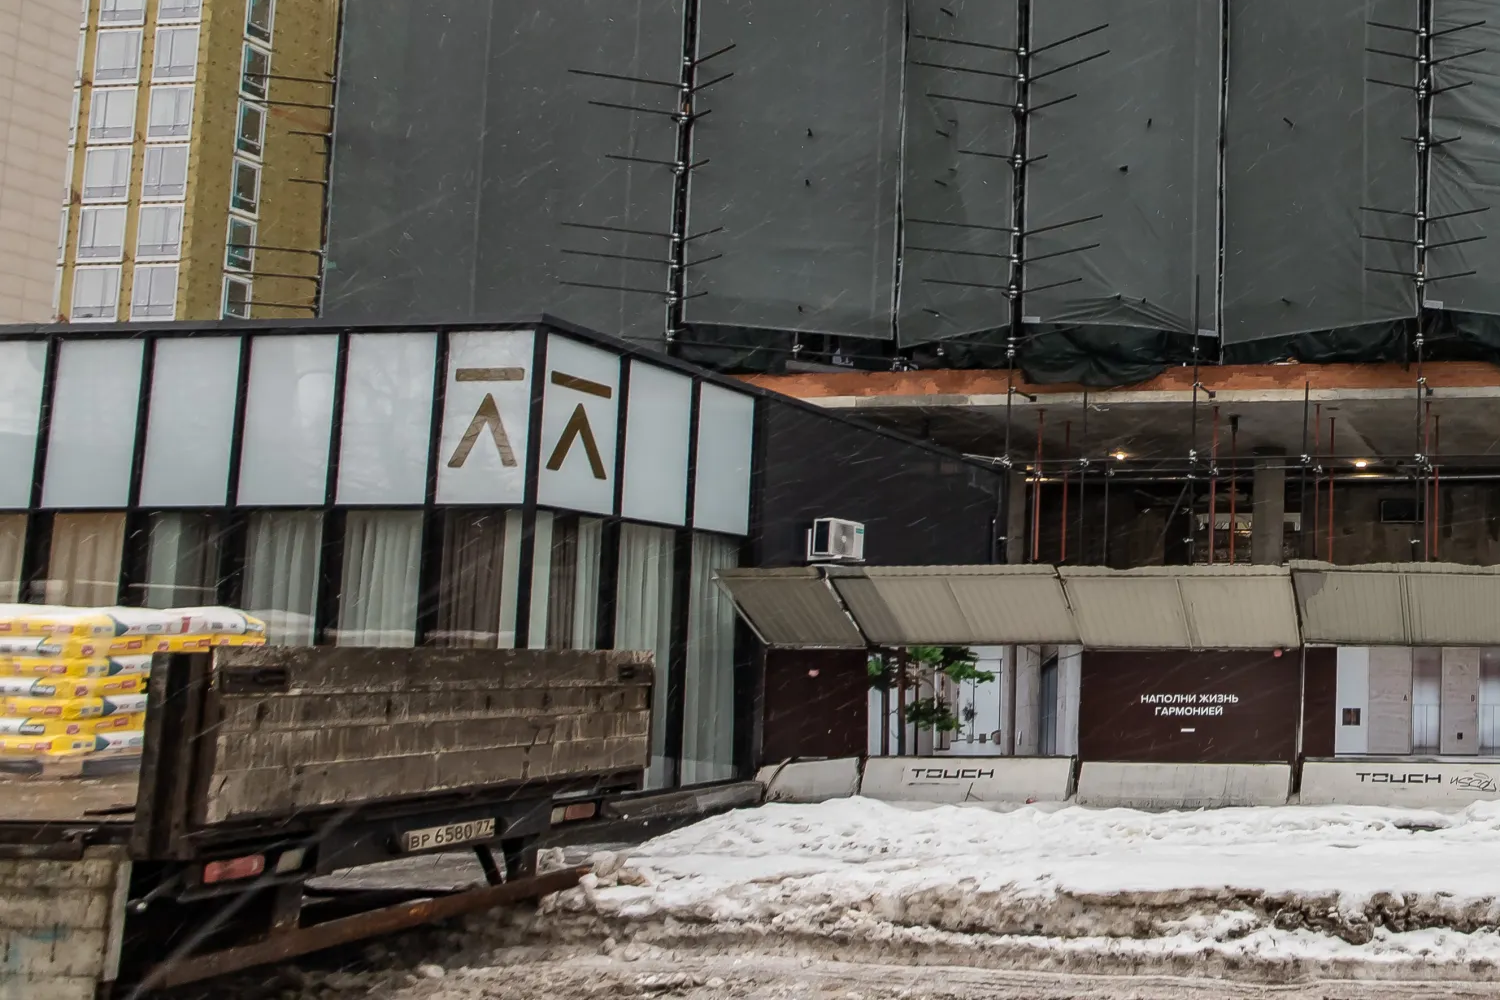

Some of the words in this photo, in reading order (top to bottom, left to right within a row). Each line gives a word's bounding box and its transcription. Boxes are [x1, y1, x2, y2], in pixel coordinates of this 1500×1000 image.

[1140, 694, 1197, 704] НАПОЛНИ
[1199, 694, 1239, 704] ЖИЗНЬ
[1154, 705, 1224, 716] ГАРМОНИЕЙ
[911, 768, 995, 779] TOUCH
[1355, 772, 1442, 784] TOUCH
[434, 825, 473, 844] 6580
